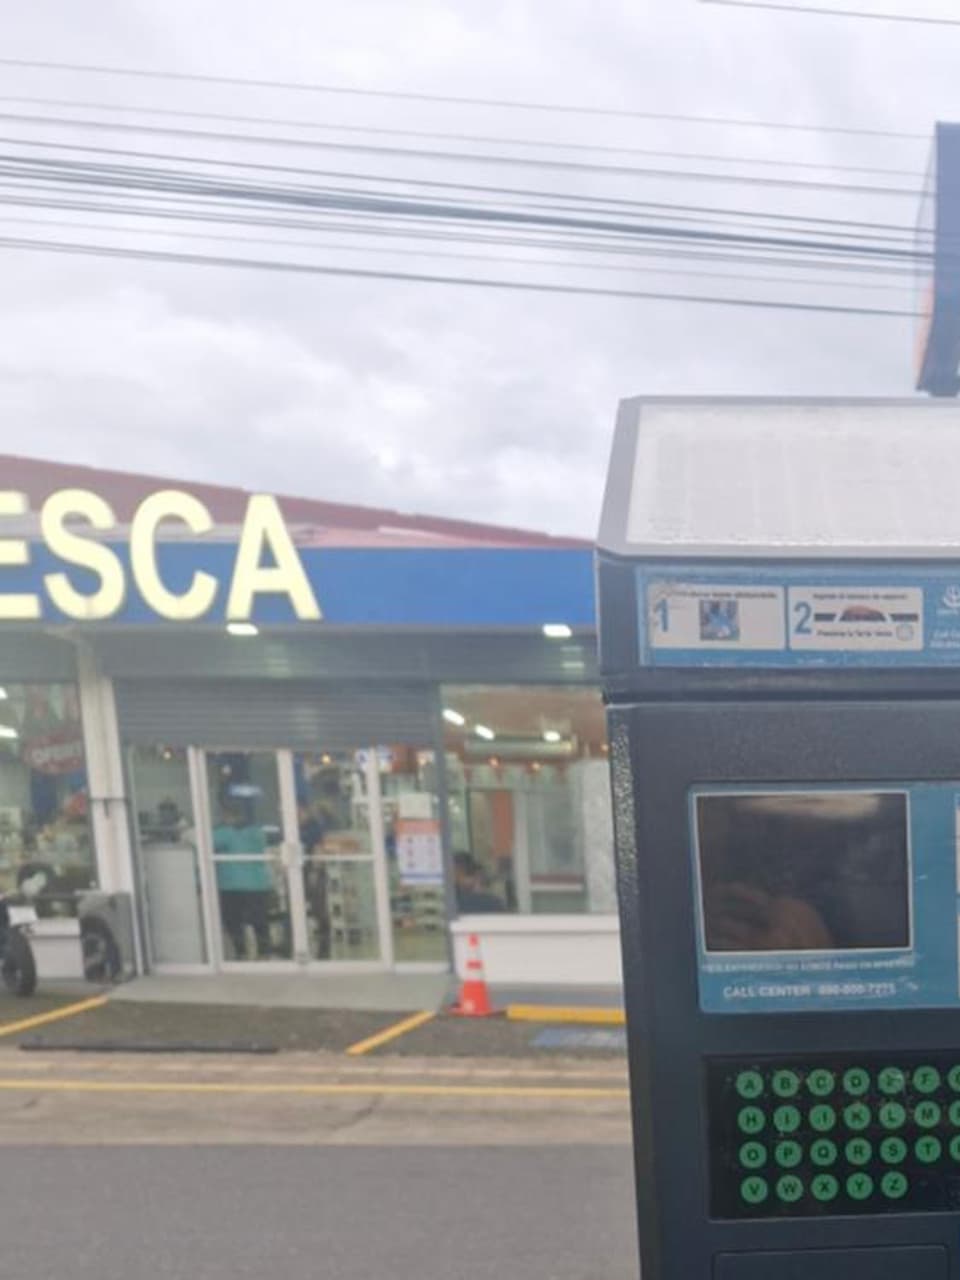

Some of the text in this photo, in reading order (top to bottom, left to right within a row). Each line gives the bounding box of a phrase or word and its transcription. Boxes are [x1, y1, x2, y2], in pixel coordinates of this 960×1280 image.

[653, 599, 669, 632] 1
[793, 601, 813, 635] 2
[723, 986, 755, 1000] CALL
[758, 984, 810, 998] CENTER
